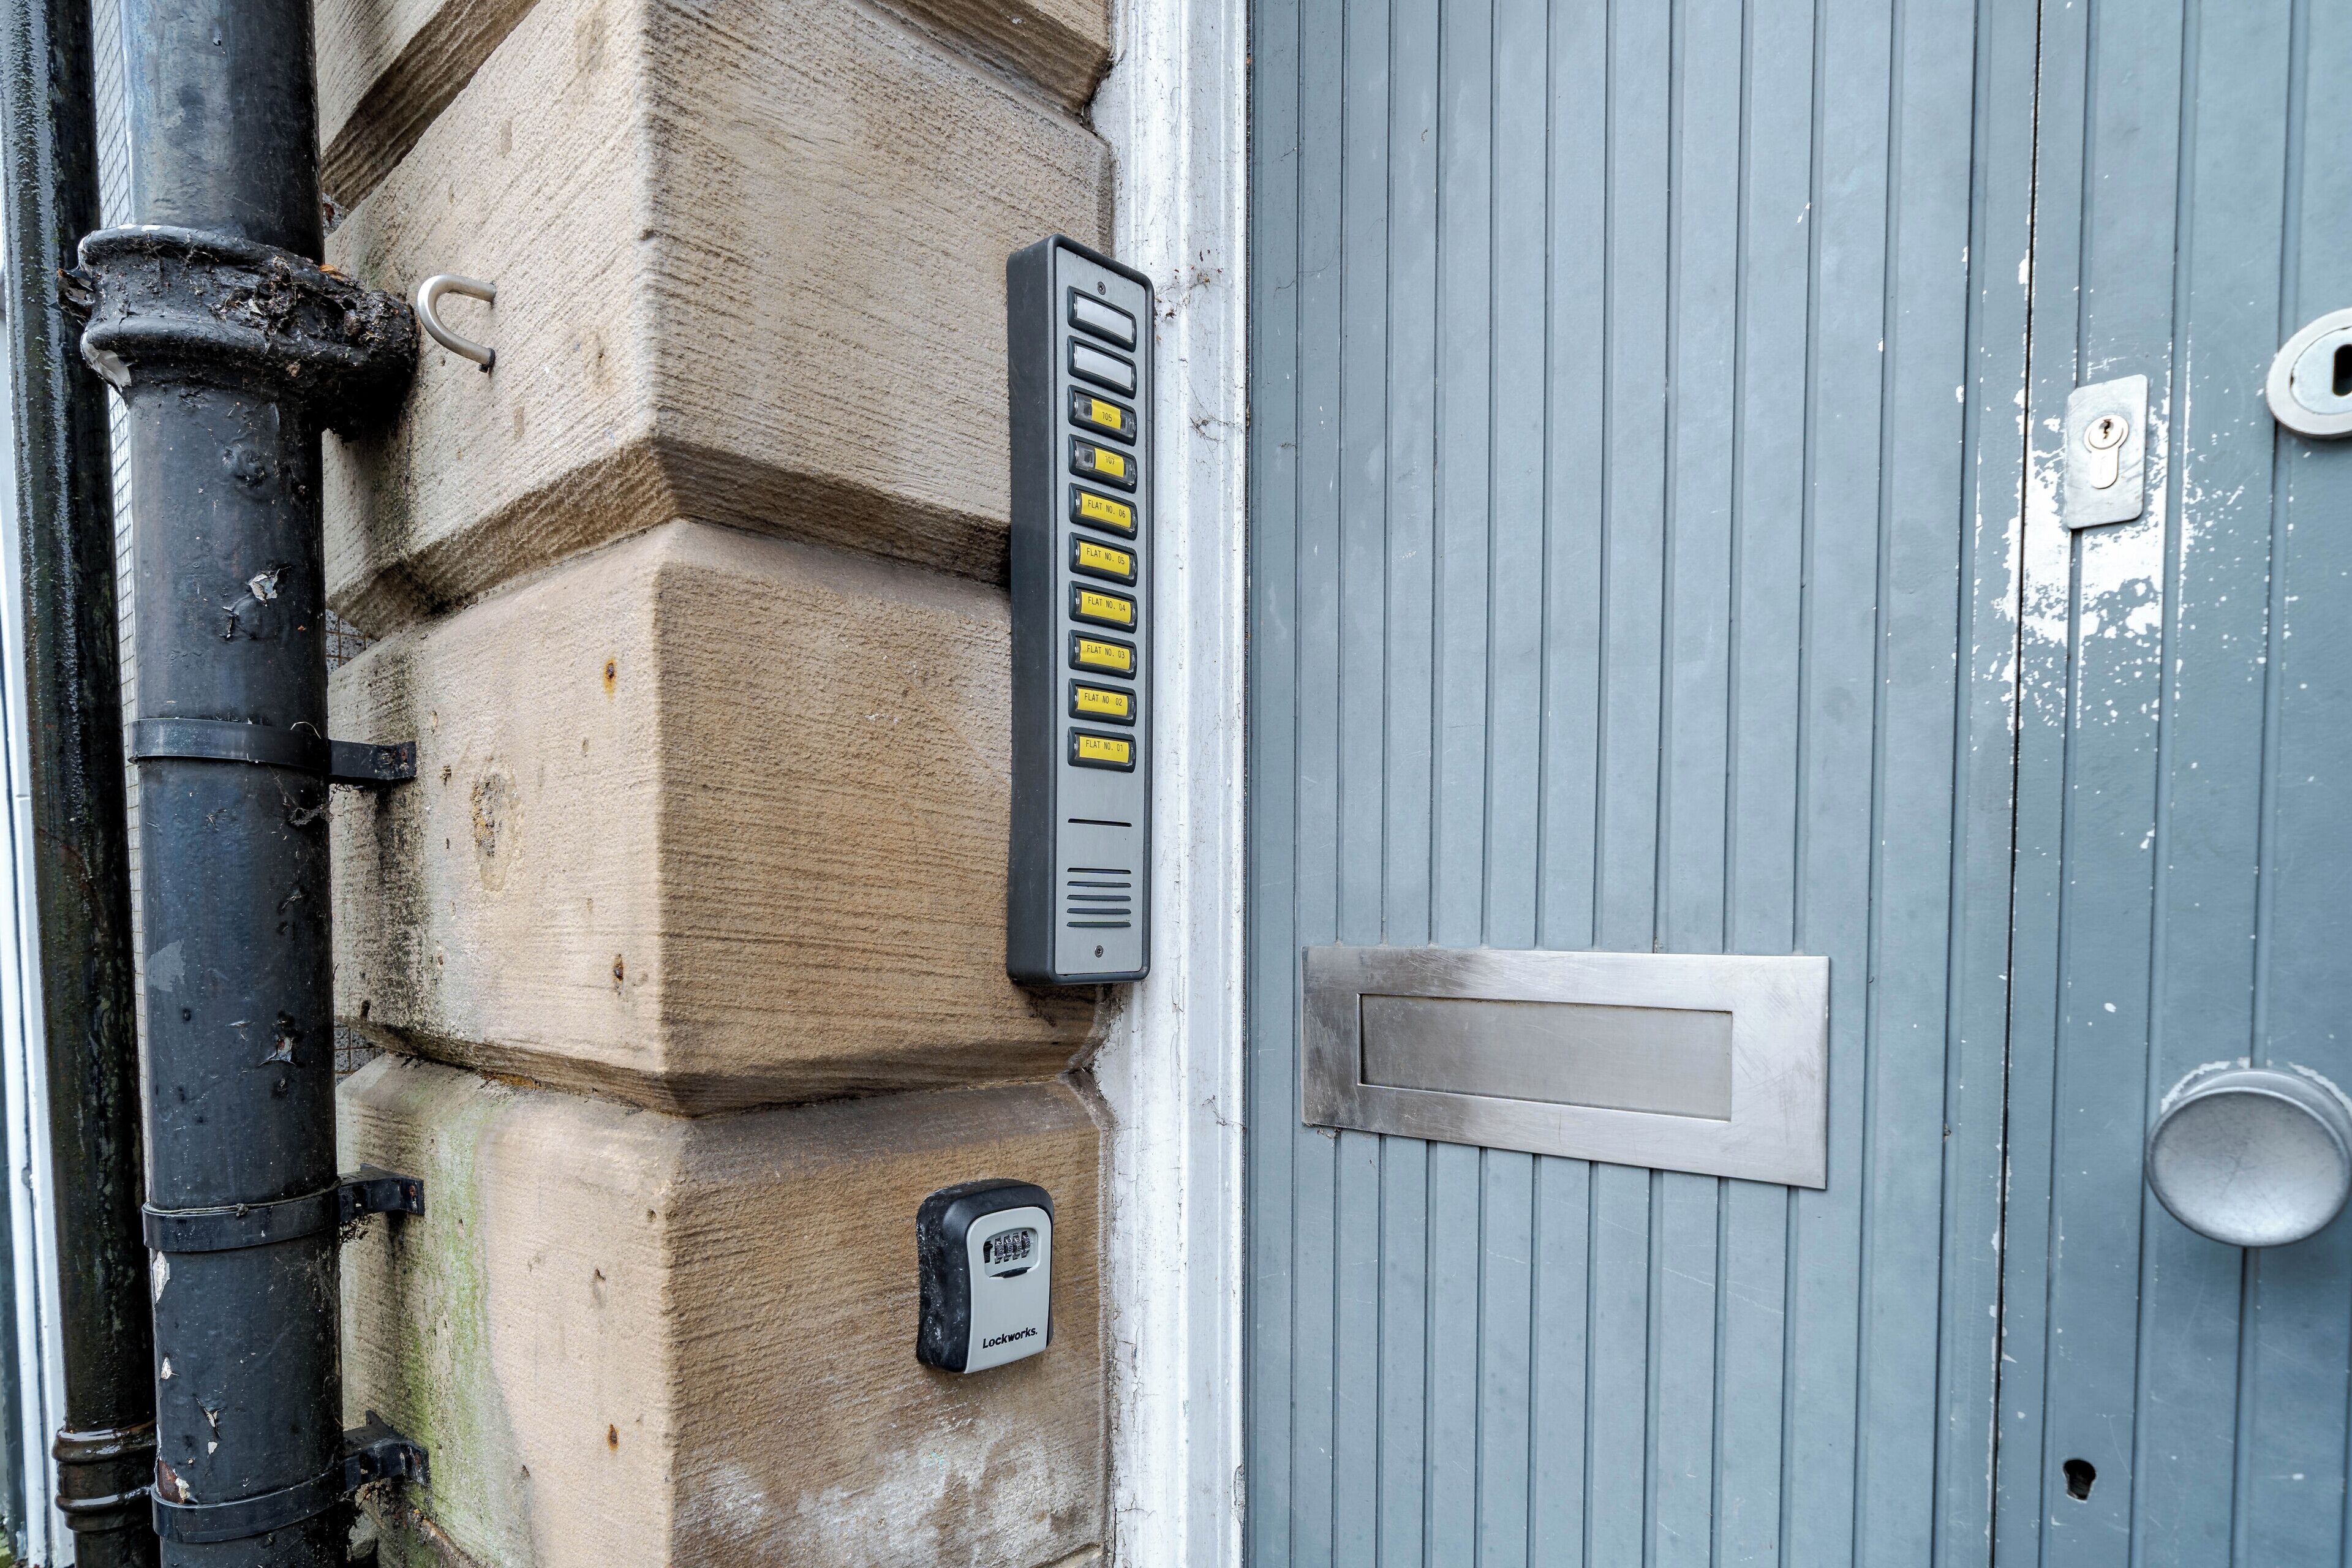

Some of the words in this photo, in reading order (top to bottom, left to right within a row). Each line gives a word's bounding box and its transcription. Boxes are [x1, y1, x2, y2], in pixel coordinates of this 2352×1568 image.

[1102, 411, 1112, 422] 105
[1105, 456, 1115, 466] 107
[1088, 499, 1102, 510] FLAT
[1106, 504, 1115, 514] NO.
[1118, 508, 1126, 518] 06
[1087, 547, 1101, 558] FLAT
[1104, 552, 1114, 562] NO.
[1118, 556, 1125, 565] 05
[1088, 596, 1102, 606] FLAT
[1106, 600, 1115, 609] NO.
[1119, 603, 1126, 612] 04
[1087, 644, 1101, 654] FLAT
[1105, 648, 1114, 657] NO.
[1118, 650, 1125, 659] 03
[1084, 692, 1099, 702] FLAT
[1115, 698, 1123, 706] 02
[1085, 739, 1101, 748] FLAT
[1104, 742, 1114, 750] NO.
[1117, 744, 1123, 752] 01
